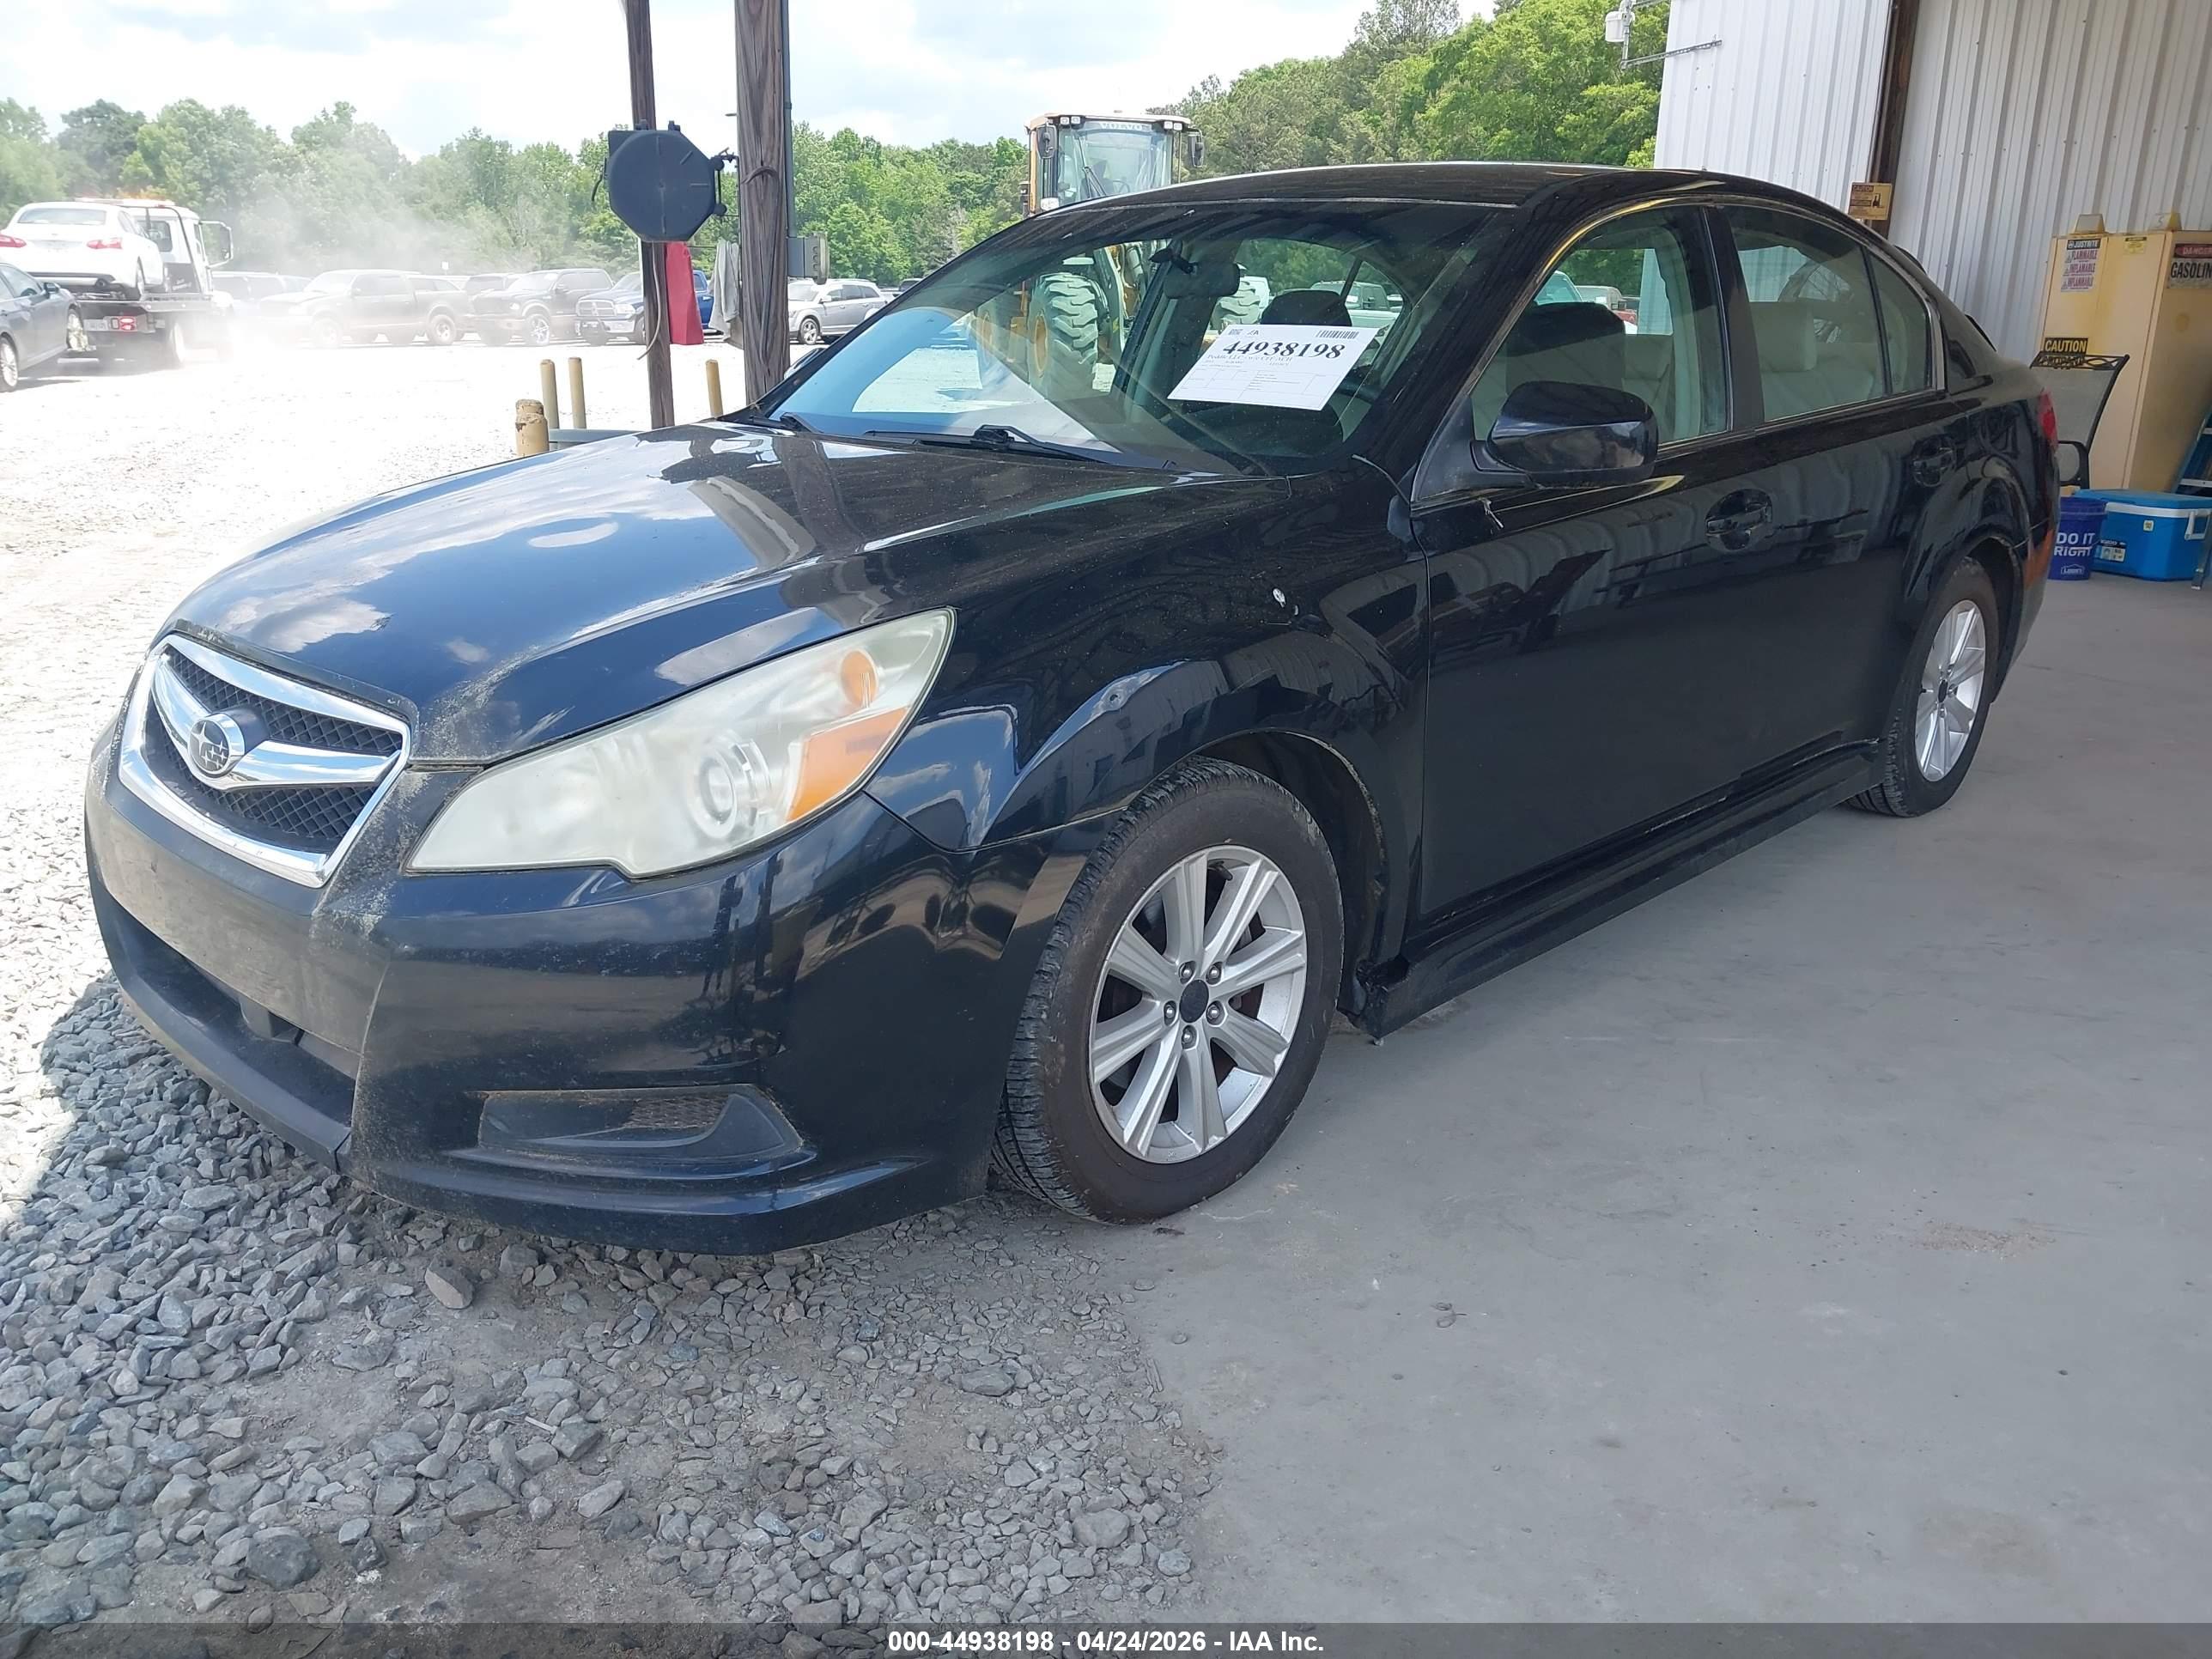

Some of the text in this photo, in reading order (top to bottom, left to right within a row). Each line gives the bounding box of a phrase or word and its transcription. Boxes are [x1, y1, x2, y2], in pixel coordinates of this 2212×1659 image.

[1223, 340, 1346, 359] 44938198
[2045, 339, 2087, 352] CAUTION
[2056, 532, 2096, 544] DO IT
[2053, 545, 2094, 556] RIGHT
